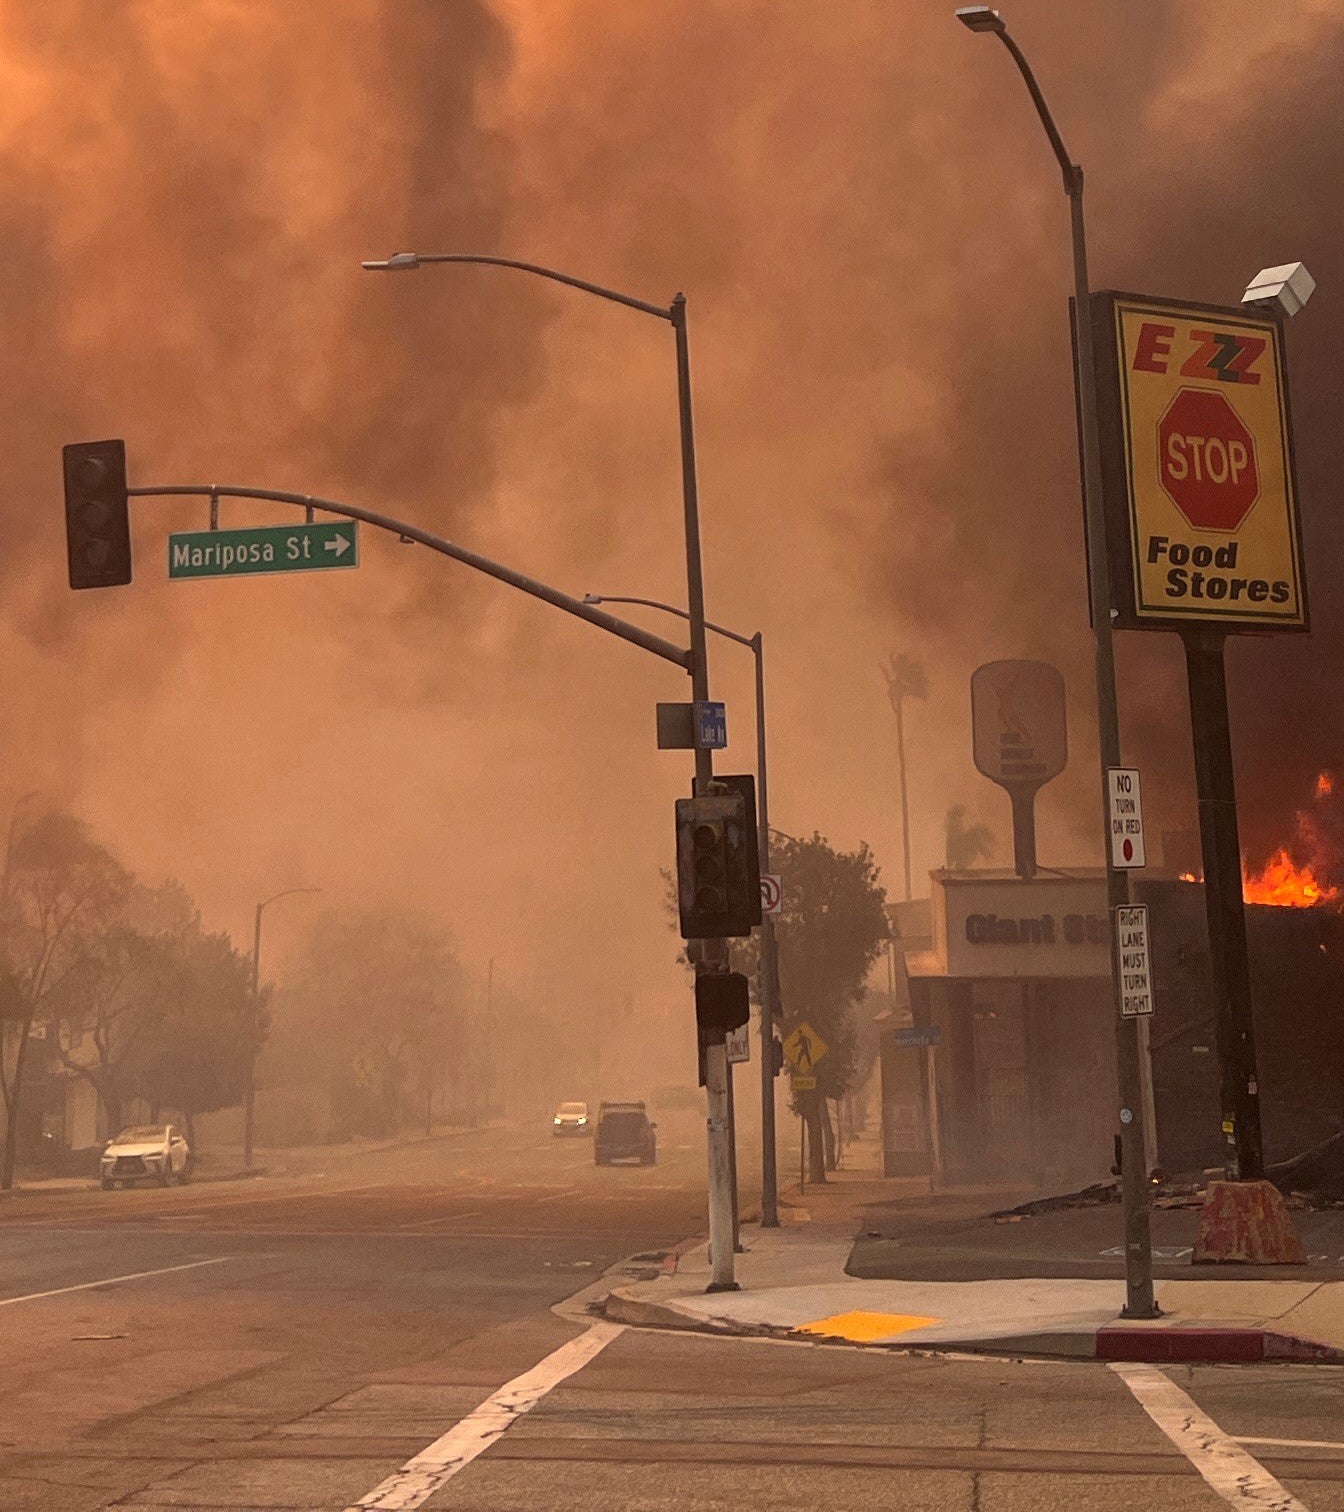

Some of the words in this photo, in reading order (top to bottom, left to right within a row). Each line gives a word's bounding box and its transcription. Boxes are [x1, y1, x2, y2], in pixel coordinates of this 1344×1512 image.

[1167, 432, 1248, 485] STOP
[173, 542, 274, 569] Mariposa
[286, 535, 311, 560] St
[1147, 536, 1238, 569] Food
[1165, 569, 1290, 603] Stores
[1117, 775, 1131, 793] NO
[1115, 799, 1136, 813] TURN
[1113, 819, 1123, 834] ON
[1126, 819, 1140, 834] RED
[1120, 910, 1144, 926] RIGHT
[1121, 931, 1144, 948] LANE
[1122, 952, 1145, 969] MUST
[1123, 973, 1147, 990] TURN
[1124, 994, 1149, 1012] RIGHT
